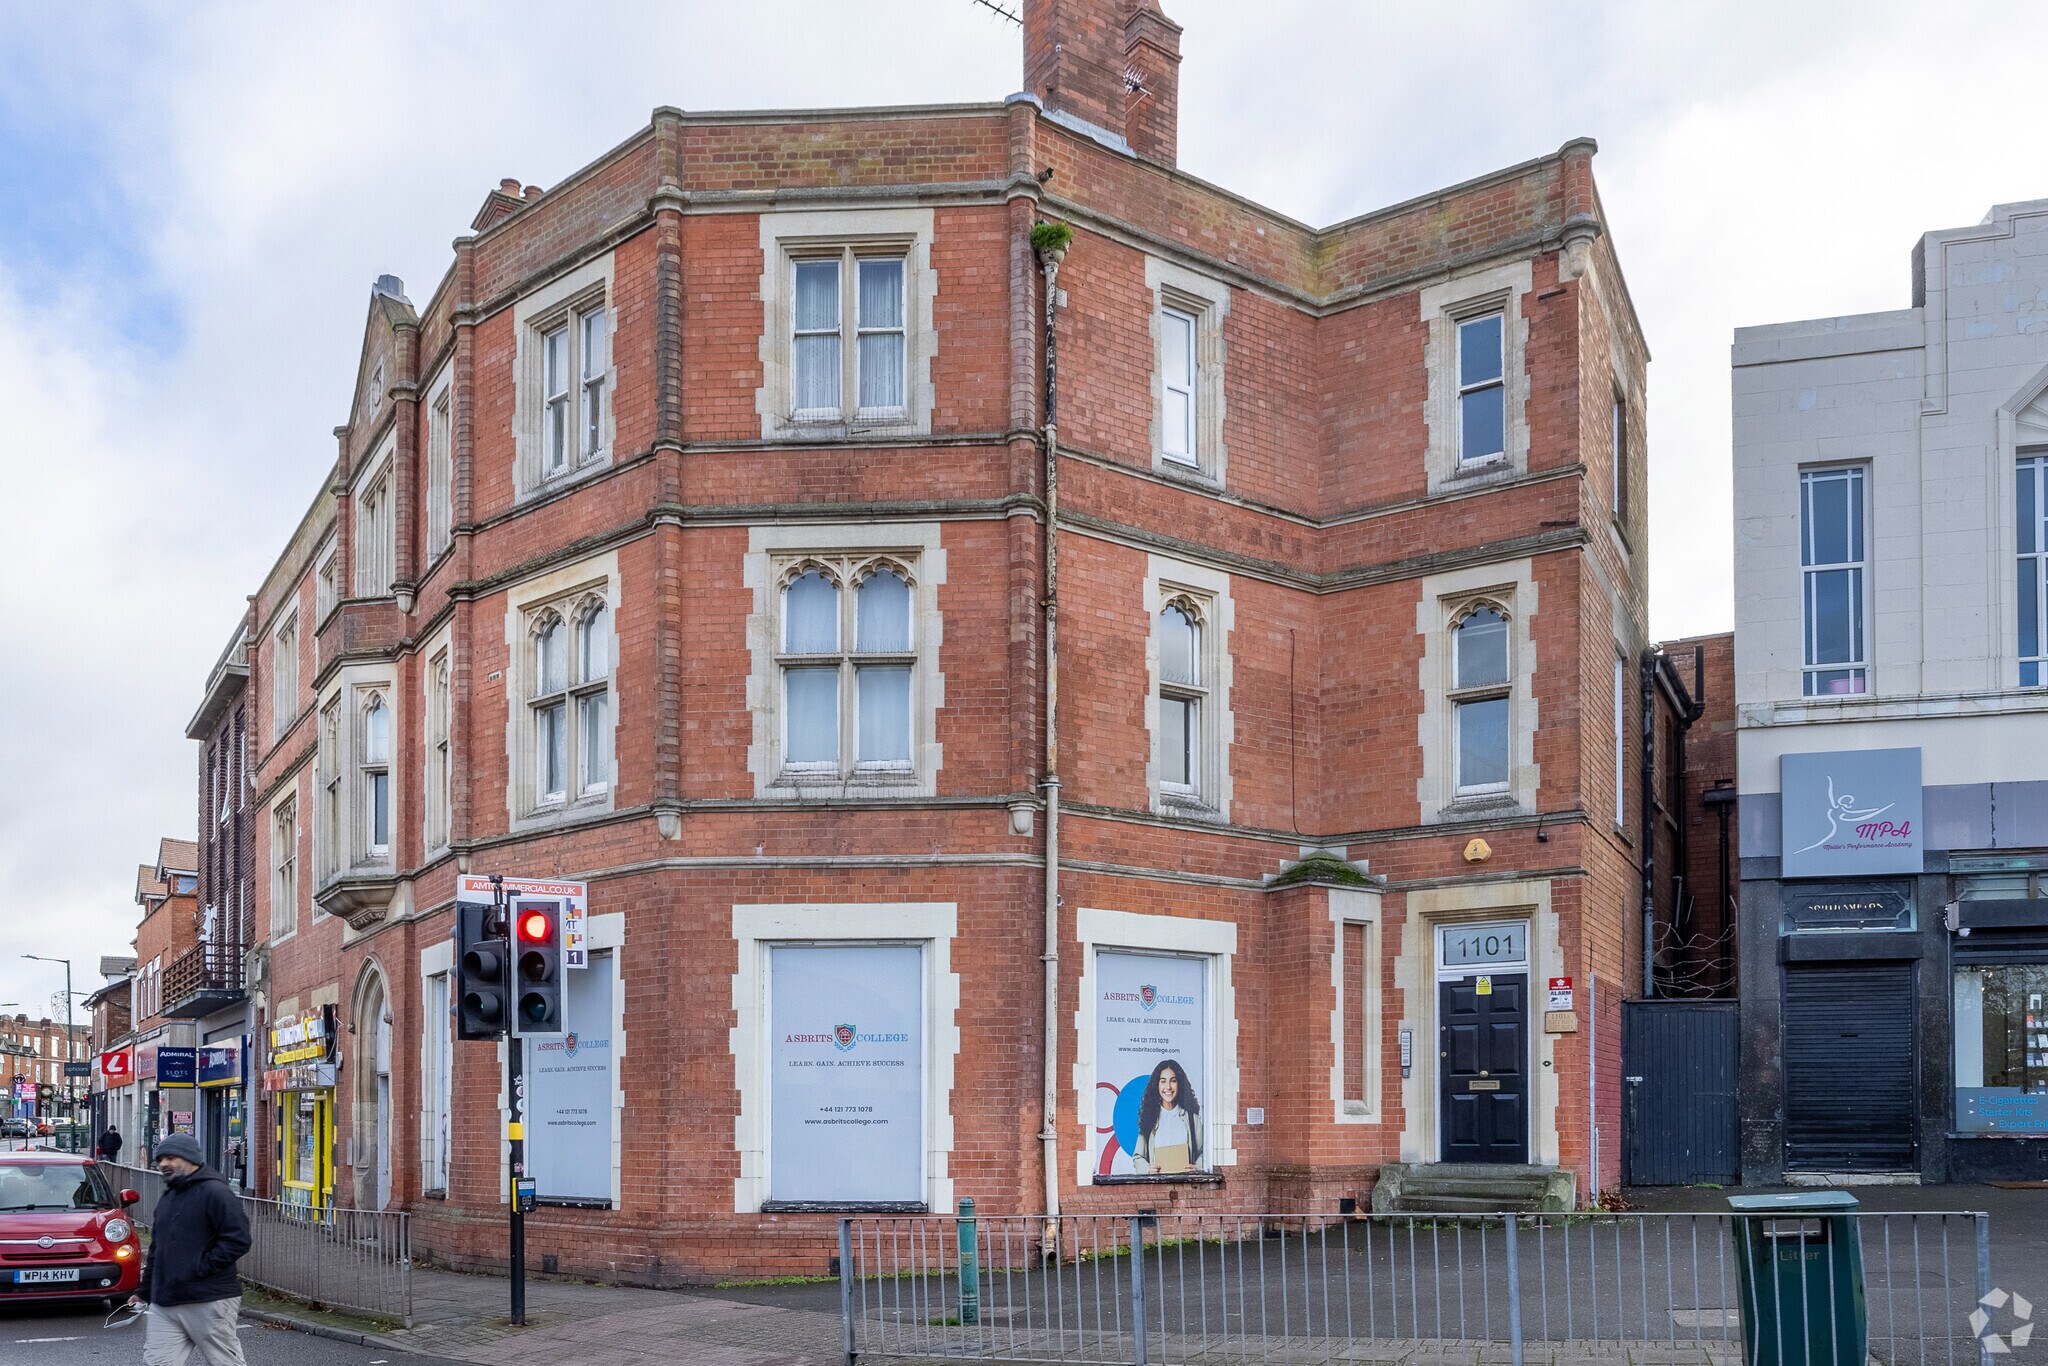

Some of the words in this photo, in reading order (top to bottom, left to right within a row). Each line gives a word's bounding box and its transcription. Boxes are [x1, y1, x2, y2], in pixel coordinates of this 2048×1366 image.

[1856, 821, 1911, 840] MPA
[1458, 935, 1512, 957] 1101
[1104, 992, 1140, 1002] ASBRITS
[1157, 995, 1194, 1004] COLLEGE
[785, 1034, 833, 1043] ASBRITS
[856, 1034, 909, 1042] COLLEGE
[537, 1042, 564, 1051] ASBRITS
[578, 1040, 609, 1049] COLLEGE
[1979, 1096, 2039, 1106] E-Cigarettes
[1979, 1107, 2013, 1116] Starter
[2015, 1107, 2033, 1116] Kits
[804, 1118, 888, 1126] www.asbritscollege.com
[1999, 1120, 2031, 1129] Expert
[1780, 1250, 1820, 1261] Liter
[24, 1271, 50, 1281] WP14
[53, 1270, 75, 1280] KHV
